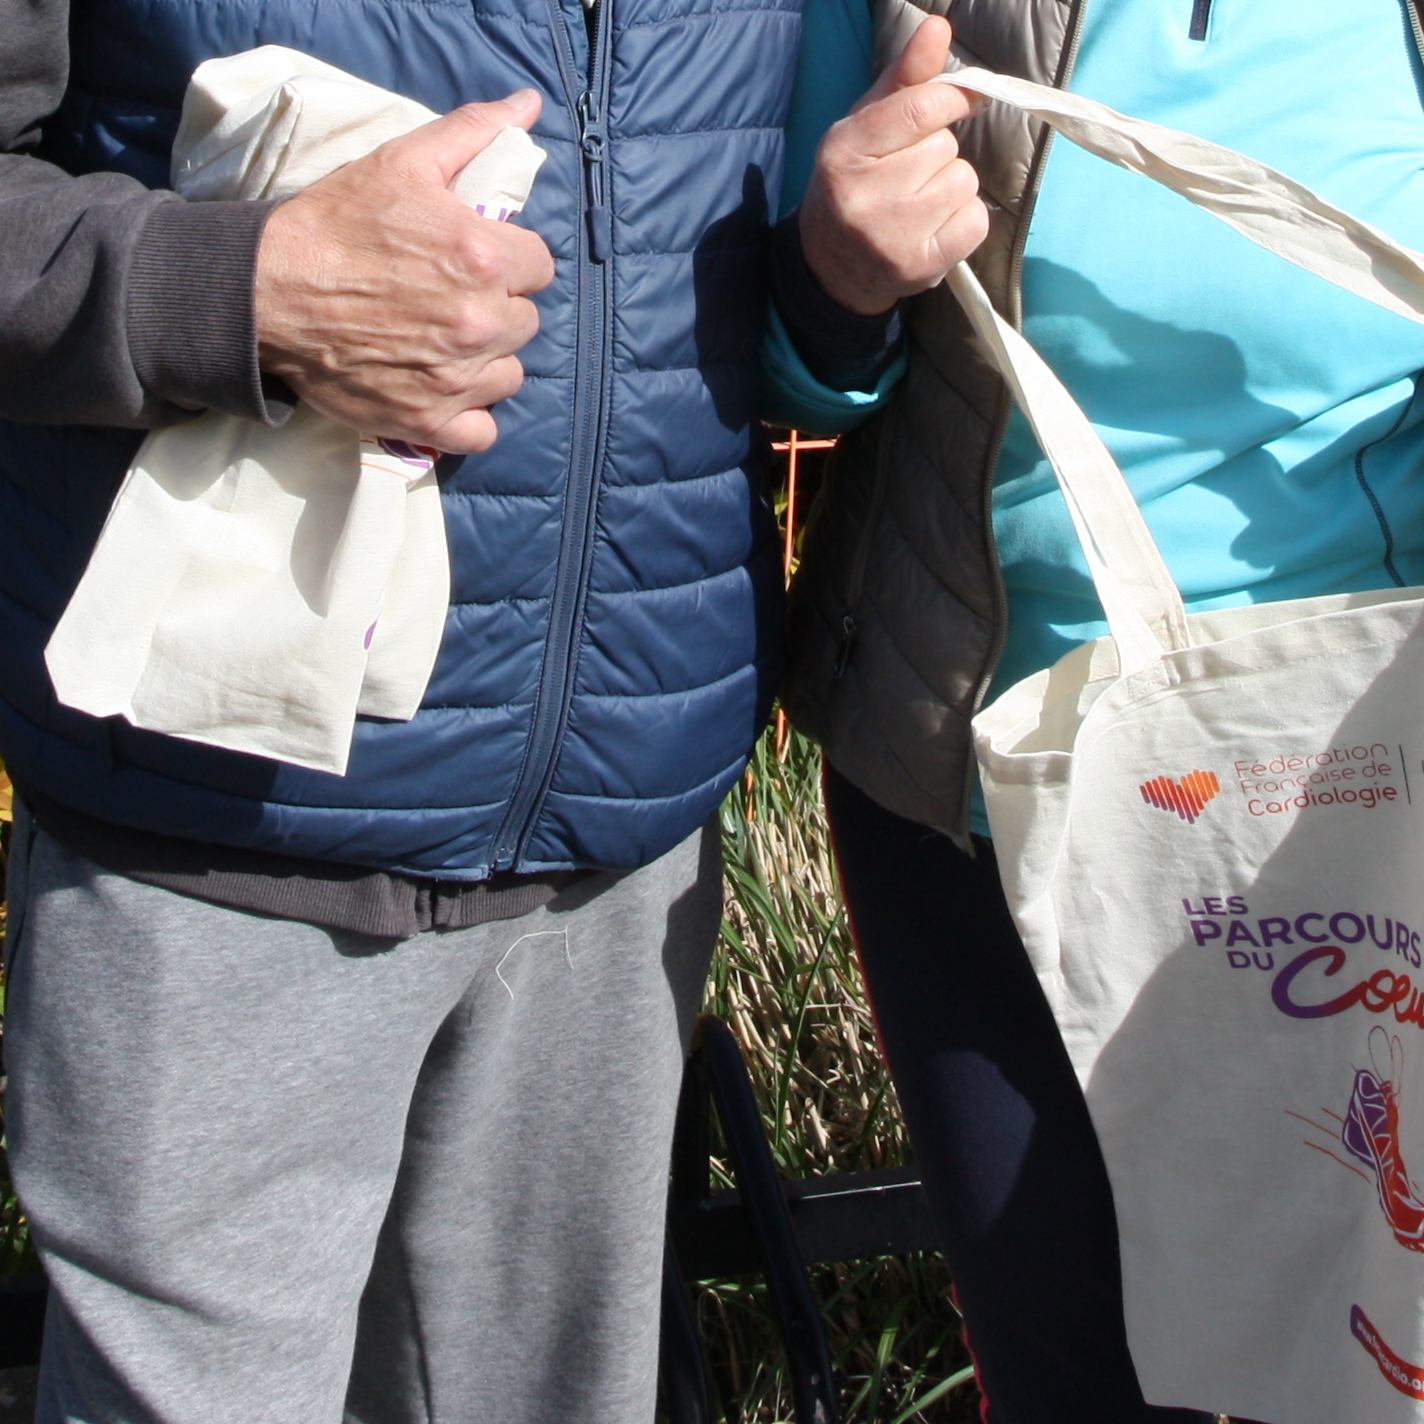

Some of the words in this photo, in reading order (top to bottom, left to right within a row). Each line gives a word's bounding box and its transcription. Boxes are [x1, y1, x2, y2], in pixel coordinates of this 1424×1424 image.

[1234, 743, 1389, 778] Fédération
[1240, 766, 1356, 795] Française
[1362, 760, 1392, 778] de
[1248, 783, 1398, 817] Cardiologie
[1181, 895, 1249, 916] LES
[1190, 911, 1422, 969] PARCOURS
[1226, 950, 1275, 971] DU
